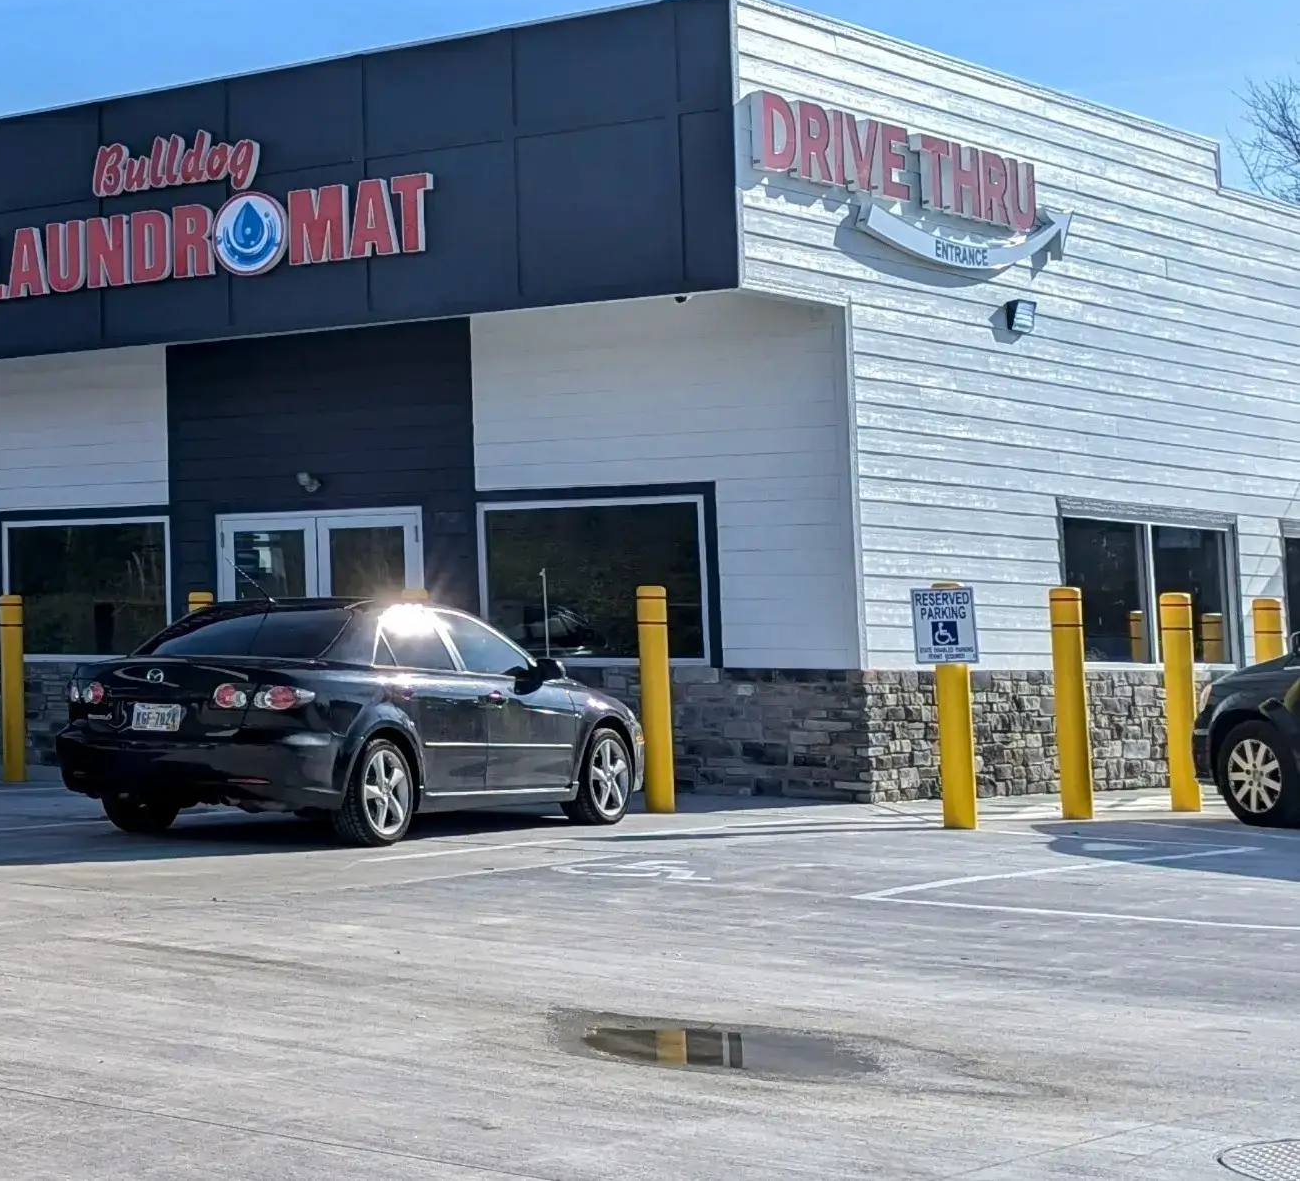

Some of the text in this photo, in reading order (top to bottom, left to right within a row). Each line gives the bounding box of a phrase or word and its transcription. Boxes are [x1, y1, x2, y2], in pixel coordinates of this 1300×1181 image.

[93, 129, 261, 196] Bulldog
[756, 90, 1036, 231] DRIVE THRU
[935, 239, 989, 268] ENTRANCE
[914, 592, 970, 606] RESERVED
[920, 606, 967, 620] PARKING
